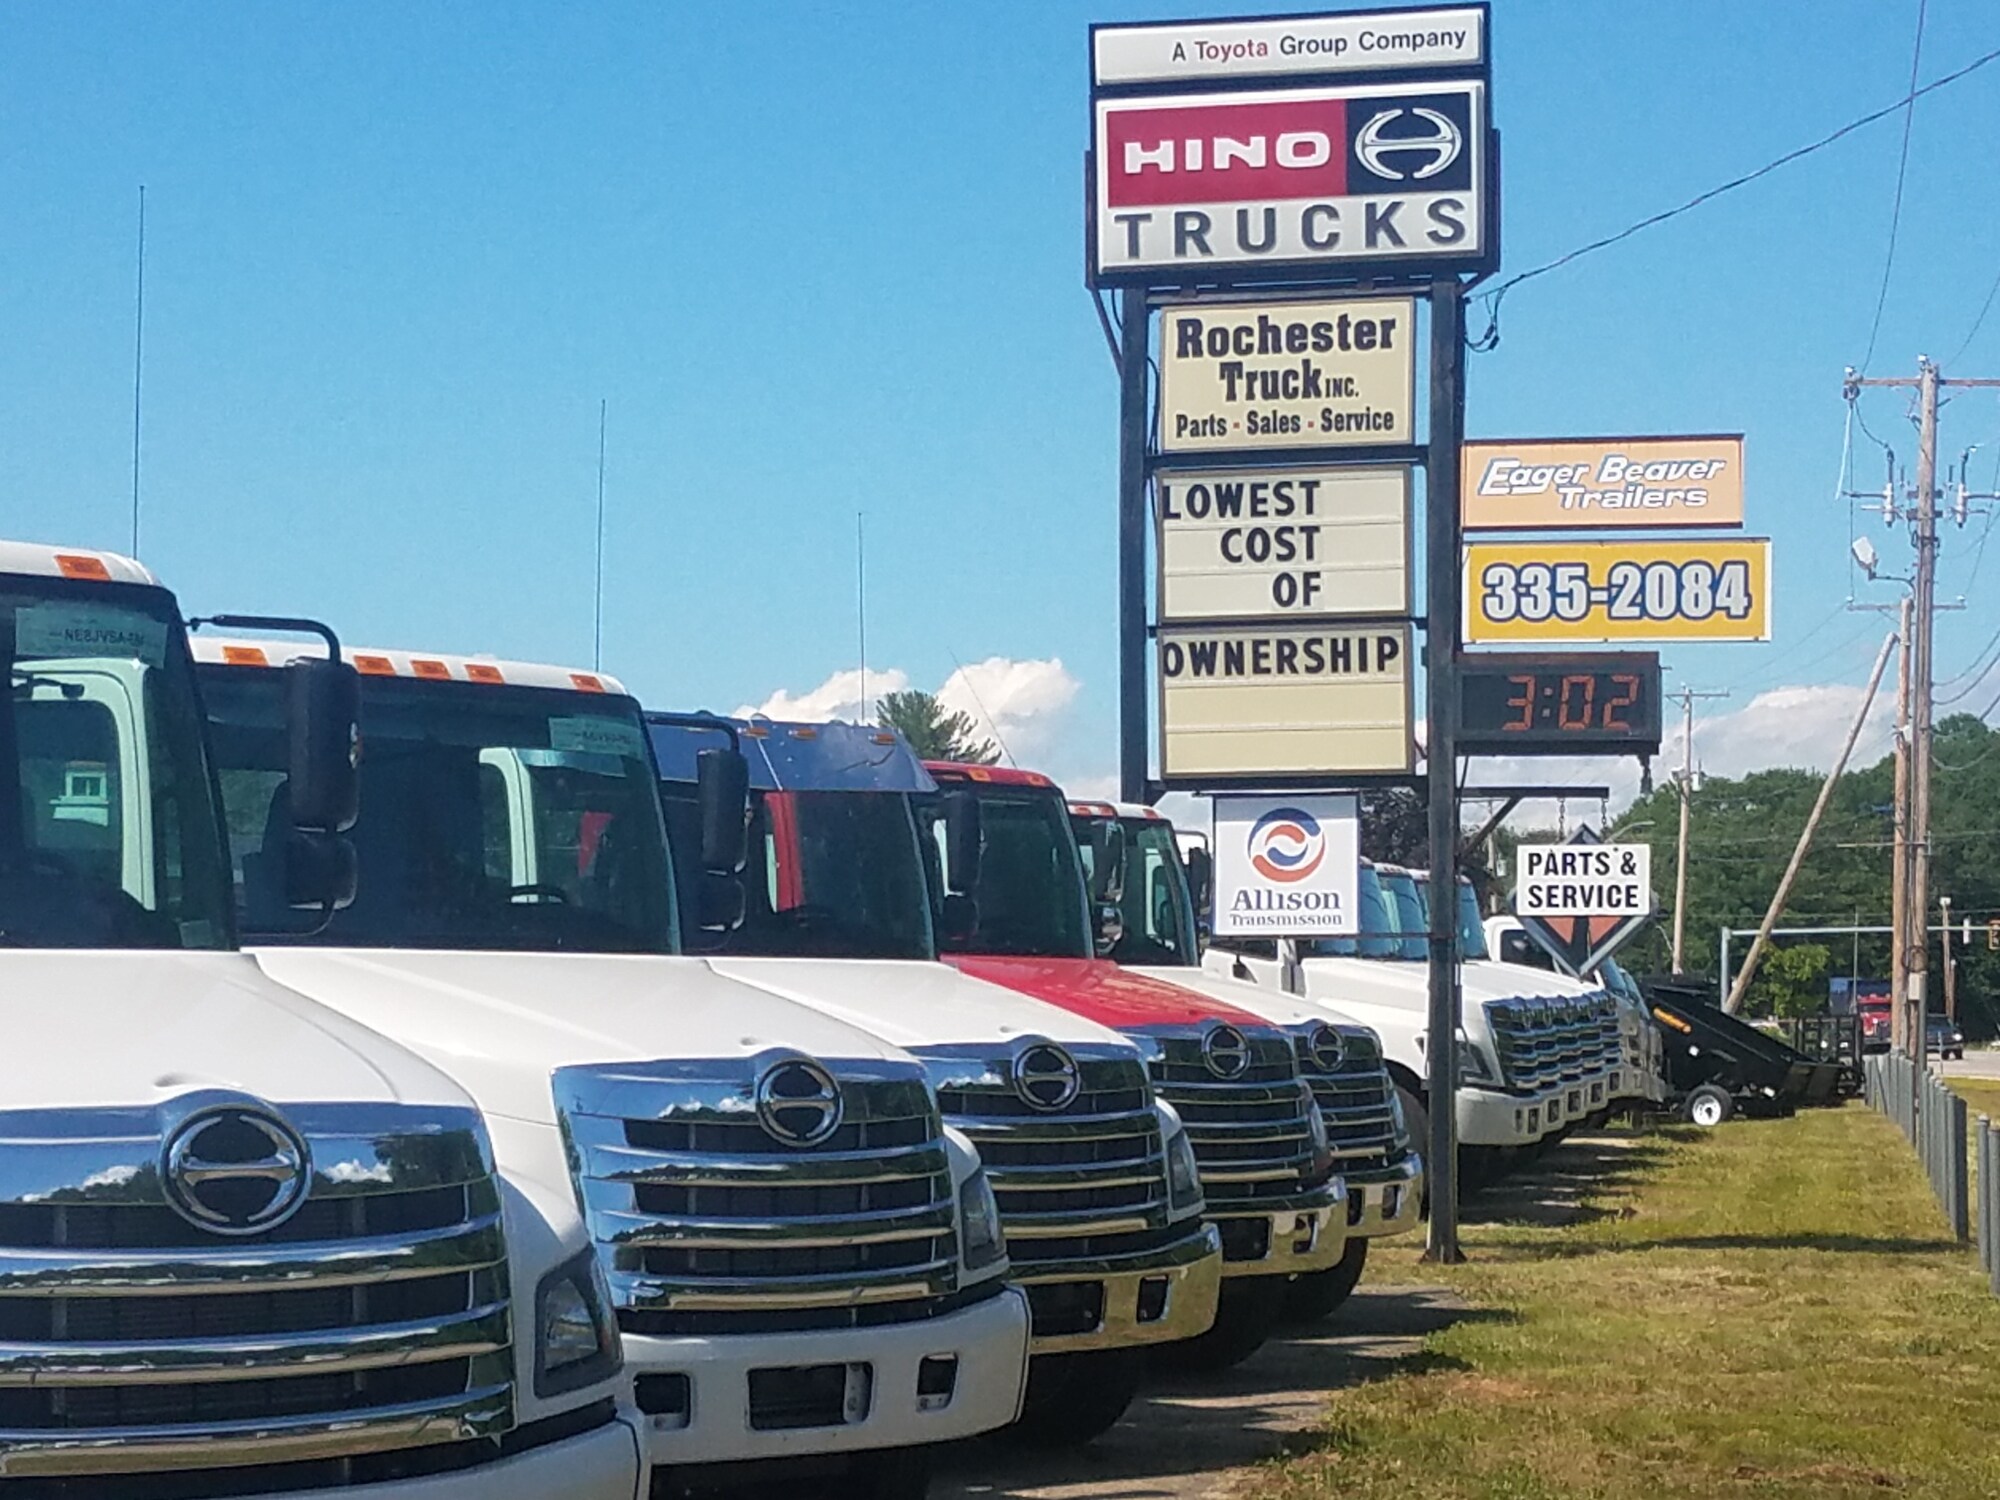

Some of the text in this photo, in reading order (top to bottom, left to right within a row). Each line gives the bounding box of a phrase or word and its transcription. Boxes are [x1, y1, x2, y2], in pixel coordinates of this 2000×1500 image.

[1172, 28, 1467, 64] A Toyota Group Company
[1124, 131, 1331, 175] HINO
[1113, 198, 1466, 260] TRUCKS
[1175, 313, 1397, 359] Rochester
[1219, 358, 1360, 402] Truck INC.
[1175, 406, 1395, 439] Parts Sales Service
[1478, 453, 1727, 496] Eager Beaver
[1162, 480, 1321, 521] LOWEST
[1556, 484, 1708, 510] Trailers
[1220, 525, 1321, 563] COST
[1272, 571, 1322, 608] OF
[1482, 560, 1752, 623] 335-2084
[1163, 635, 1400, 678] OWNERSHIP
[1502, 674, 1640, 731] 3:02
[1528, 851, 1637, 876] PARTS &
[1230, 889, 1342, 911] Allison
[1528, 884, 1639, 908] SERVICE
[1229, 913, 1343, 926] Transmission
